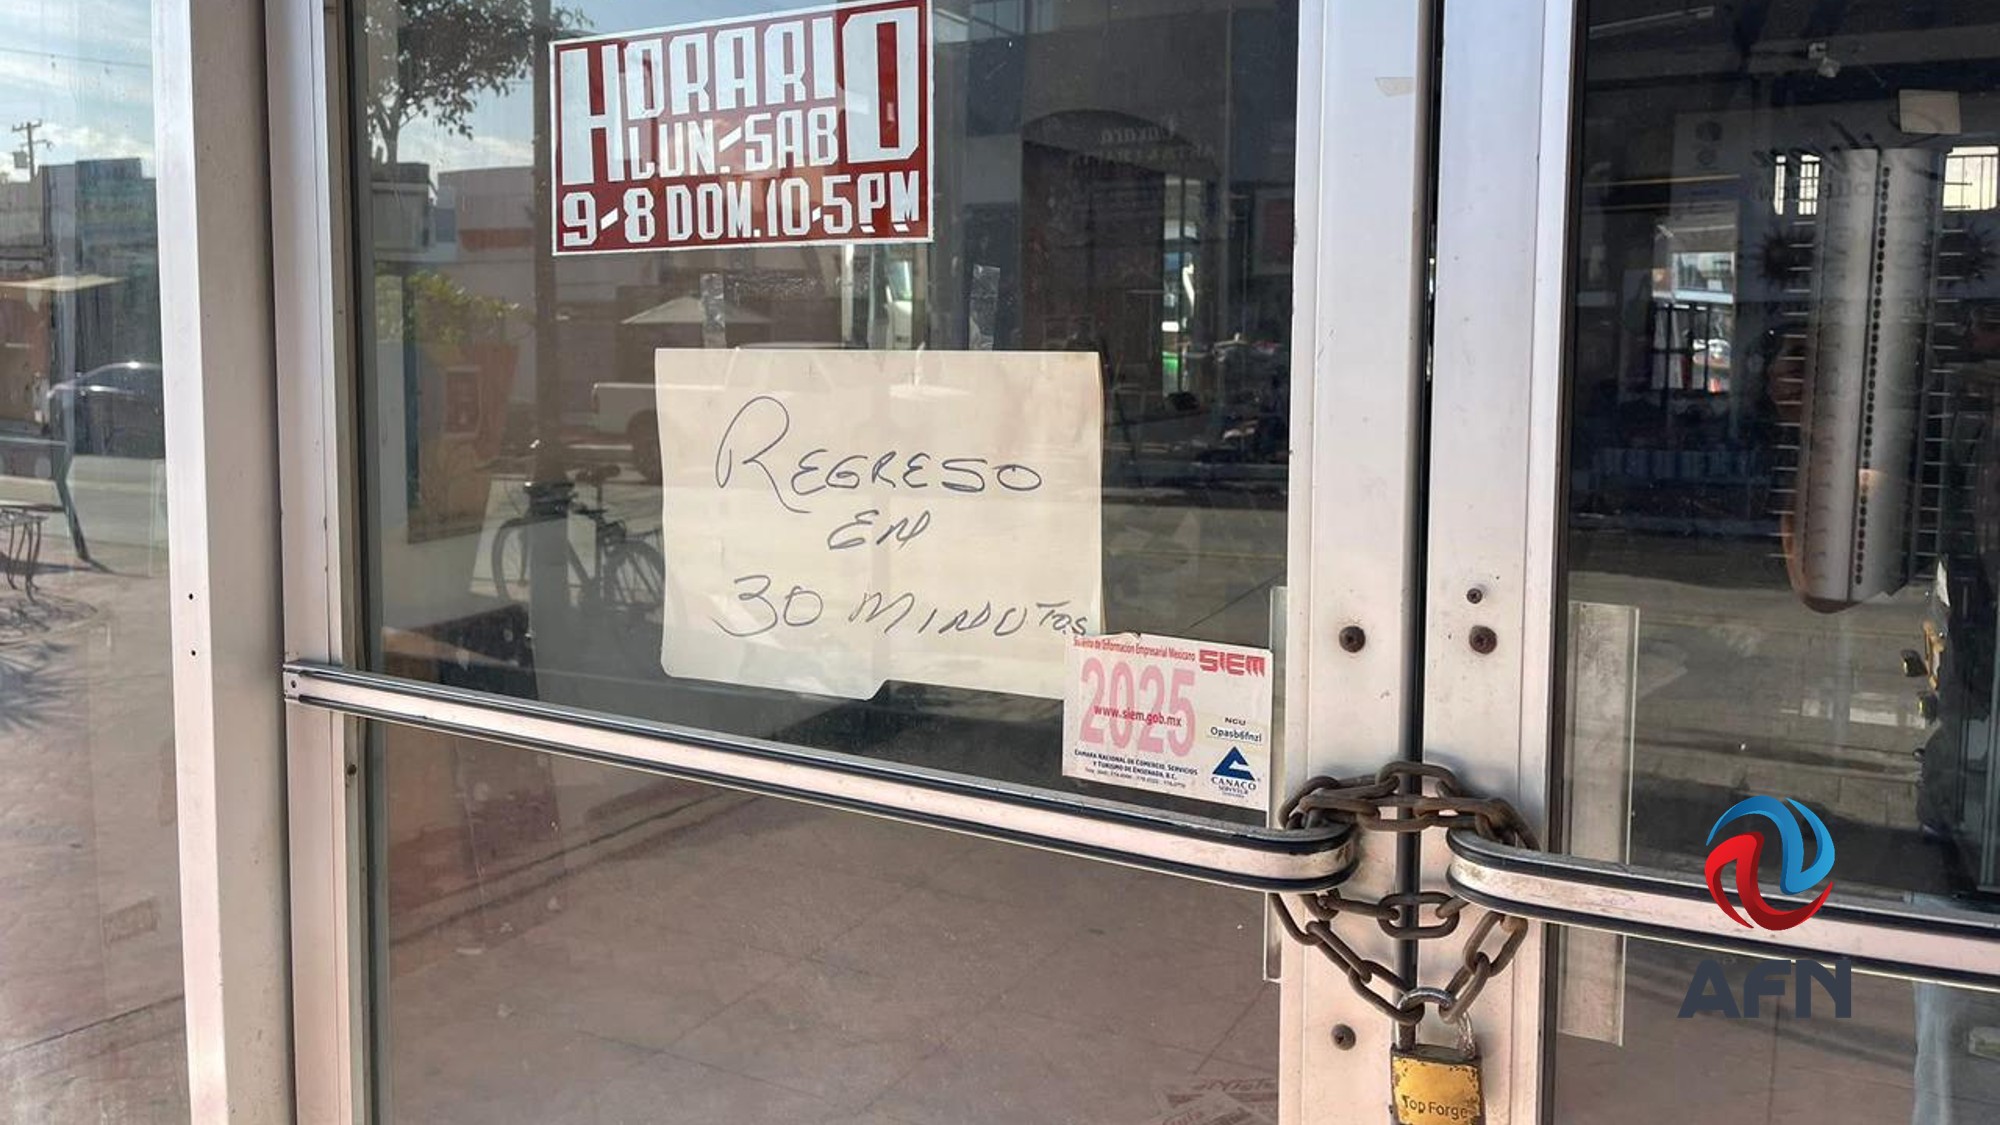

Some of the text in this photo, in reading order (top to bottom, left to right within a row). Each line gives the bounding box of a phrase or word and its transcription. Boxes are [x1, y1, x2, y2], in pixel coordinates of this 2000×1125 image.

[559, 6, 920, 186] HORARIO
[715, 396, 1042, 513] REGRESO
[827, 510, 931, 550] EN
[711, 574, 823, 637] 30
[1199, 649, 1265, 677] SIEM
[1080, 657, 1196, 757] 2025
[1093, 704, 1182, 728] www.siem.gob.mx
[1211, 777, 1257, 791] CANACO
[1401, 1094, 1468, 1121] Top Forge
